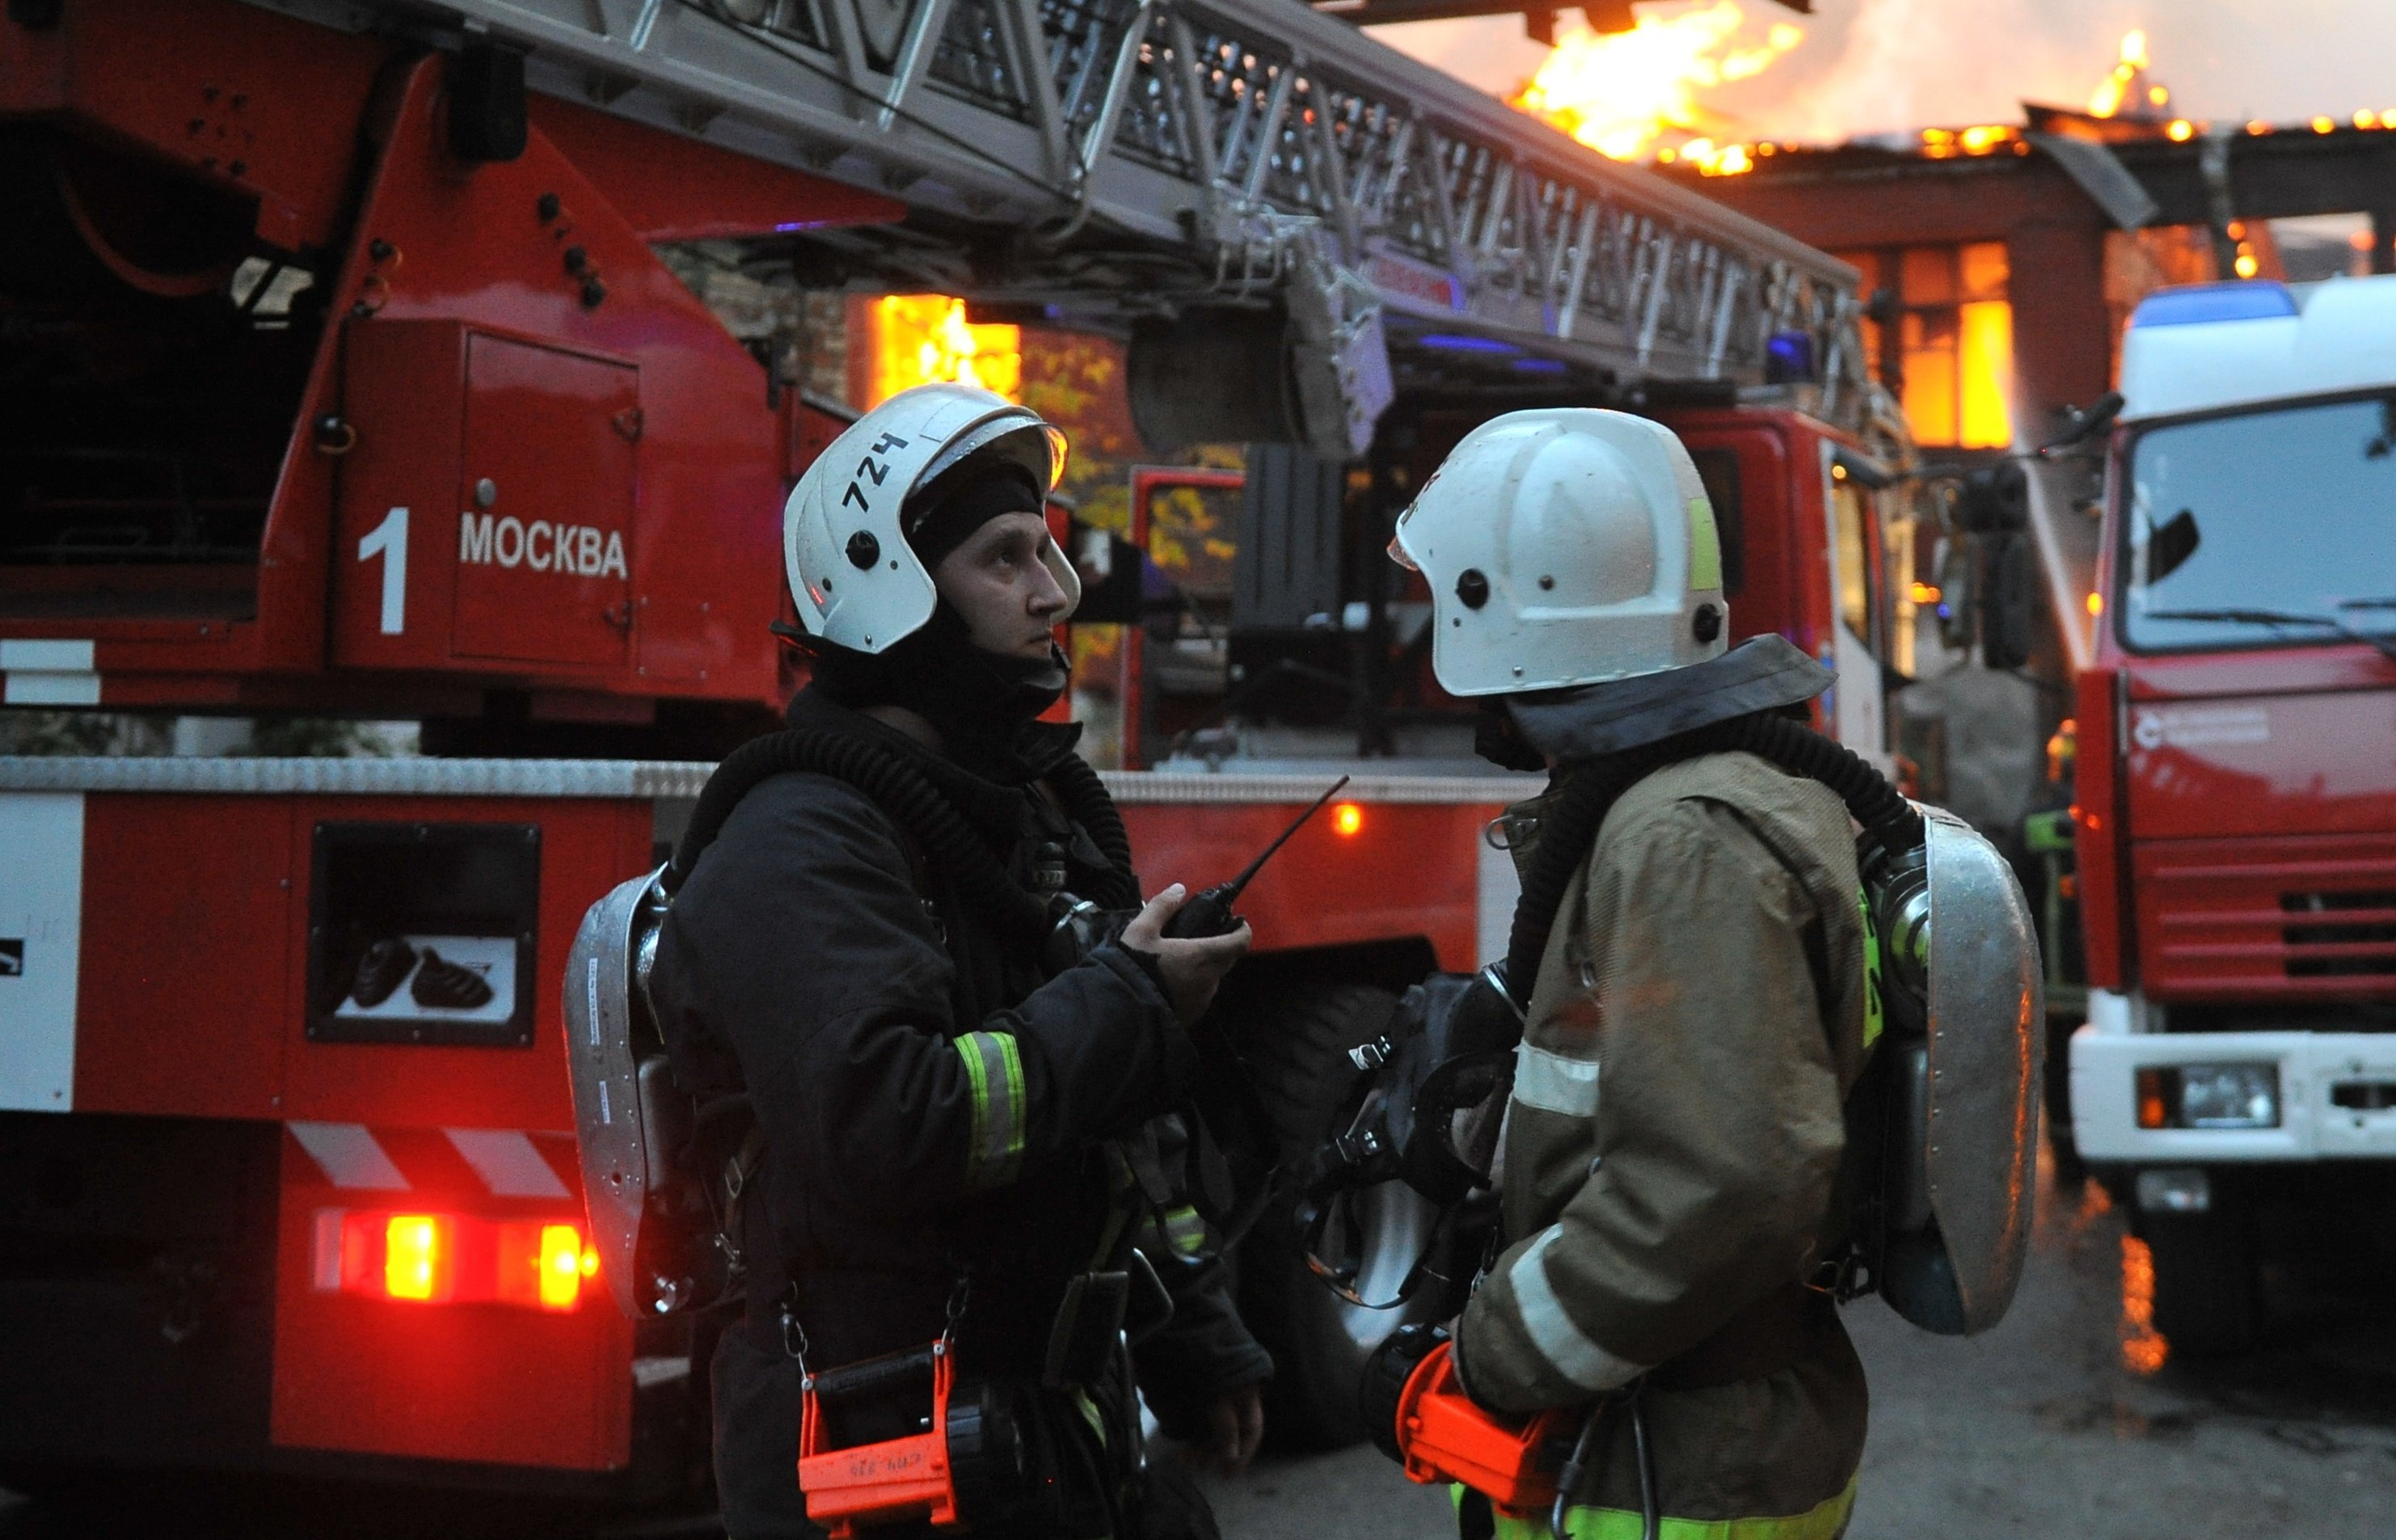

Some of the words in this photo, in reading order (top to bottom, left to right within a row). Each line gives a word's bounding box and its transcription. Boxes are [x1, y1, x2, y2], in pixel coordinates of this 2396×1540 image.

[842, 432, 909, 513] 724
[357, 506, 410, 635] 1
[459, 511, 628, 580] МОСКВА
